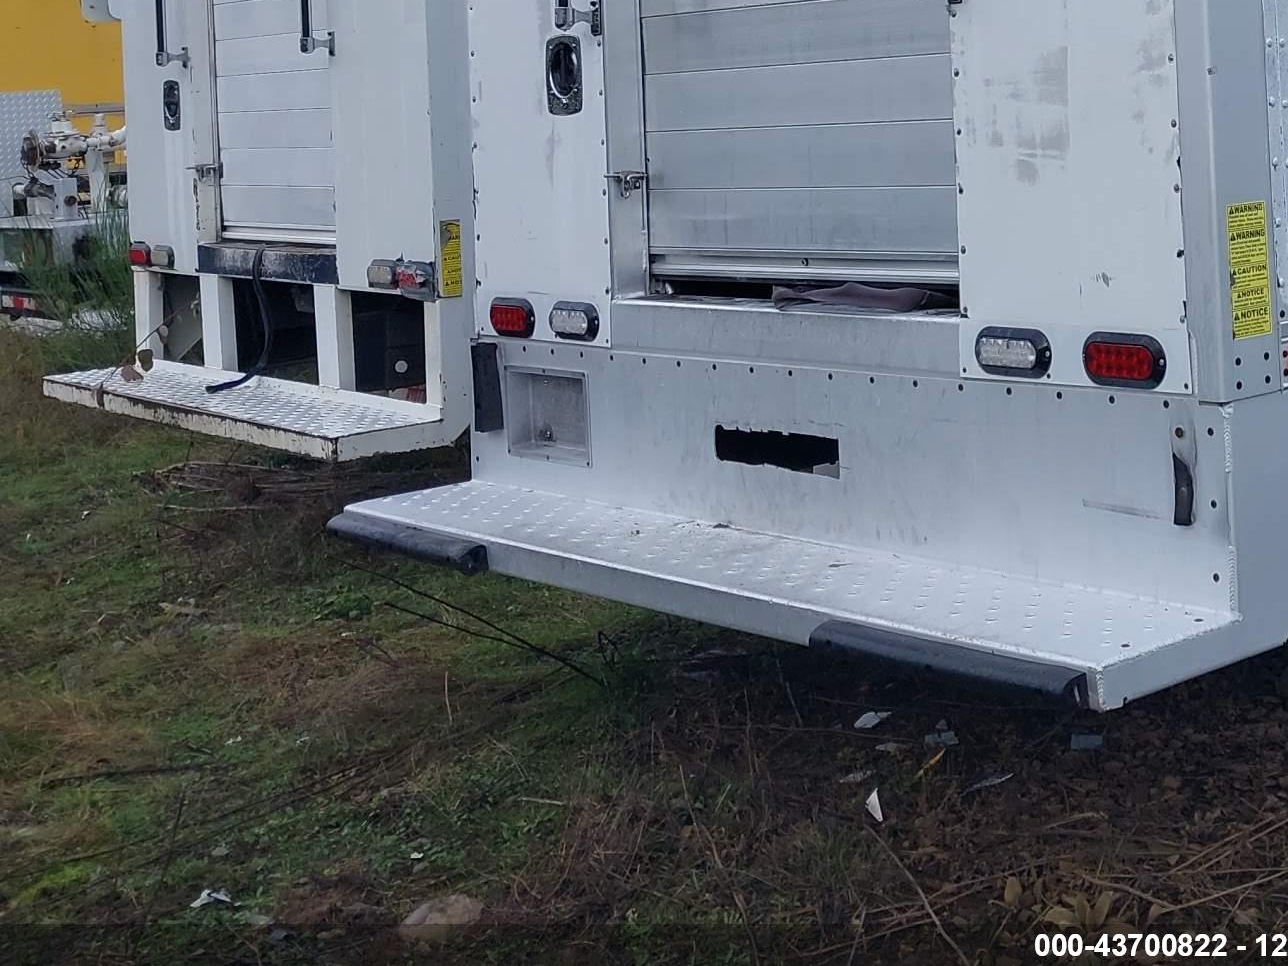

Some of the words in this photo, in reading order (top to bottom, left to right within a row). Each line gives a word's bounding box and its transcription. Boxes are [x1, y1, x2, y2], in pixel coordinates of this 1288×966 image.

[1237, 264, 1267, 275] CAUTION
[1241, 287, 1265, 298] NOTICE
[1240, 306, 1269, 320] NOTICE
